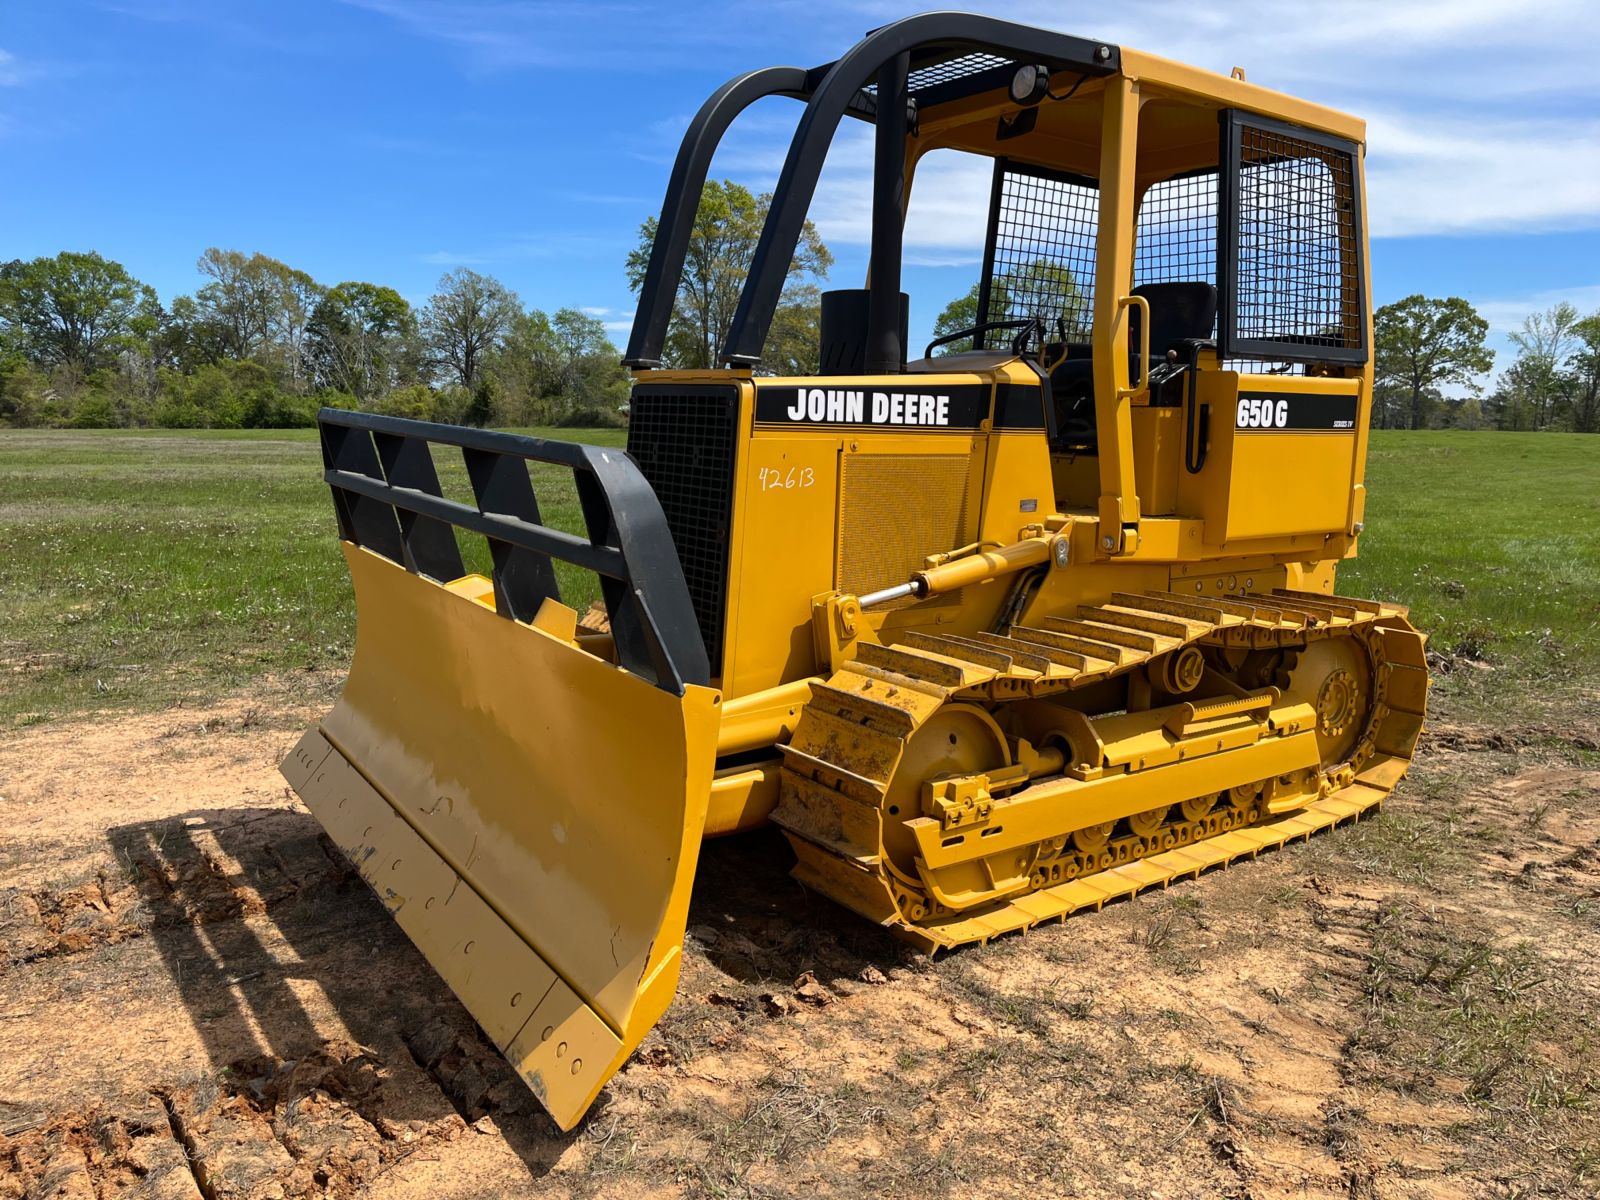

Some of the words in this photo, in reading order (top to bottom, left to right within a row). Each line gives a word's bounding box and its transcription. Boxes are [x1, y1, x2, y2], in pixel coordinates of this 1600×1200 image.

[787, 388, 864, 423] JOHN
[871, 392, 949, 425] DEERE
[759, 467, 815, 491] 42613
